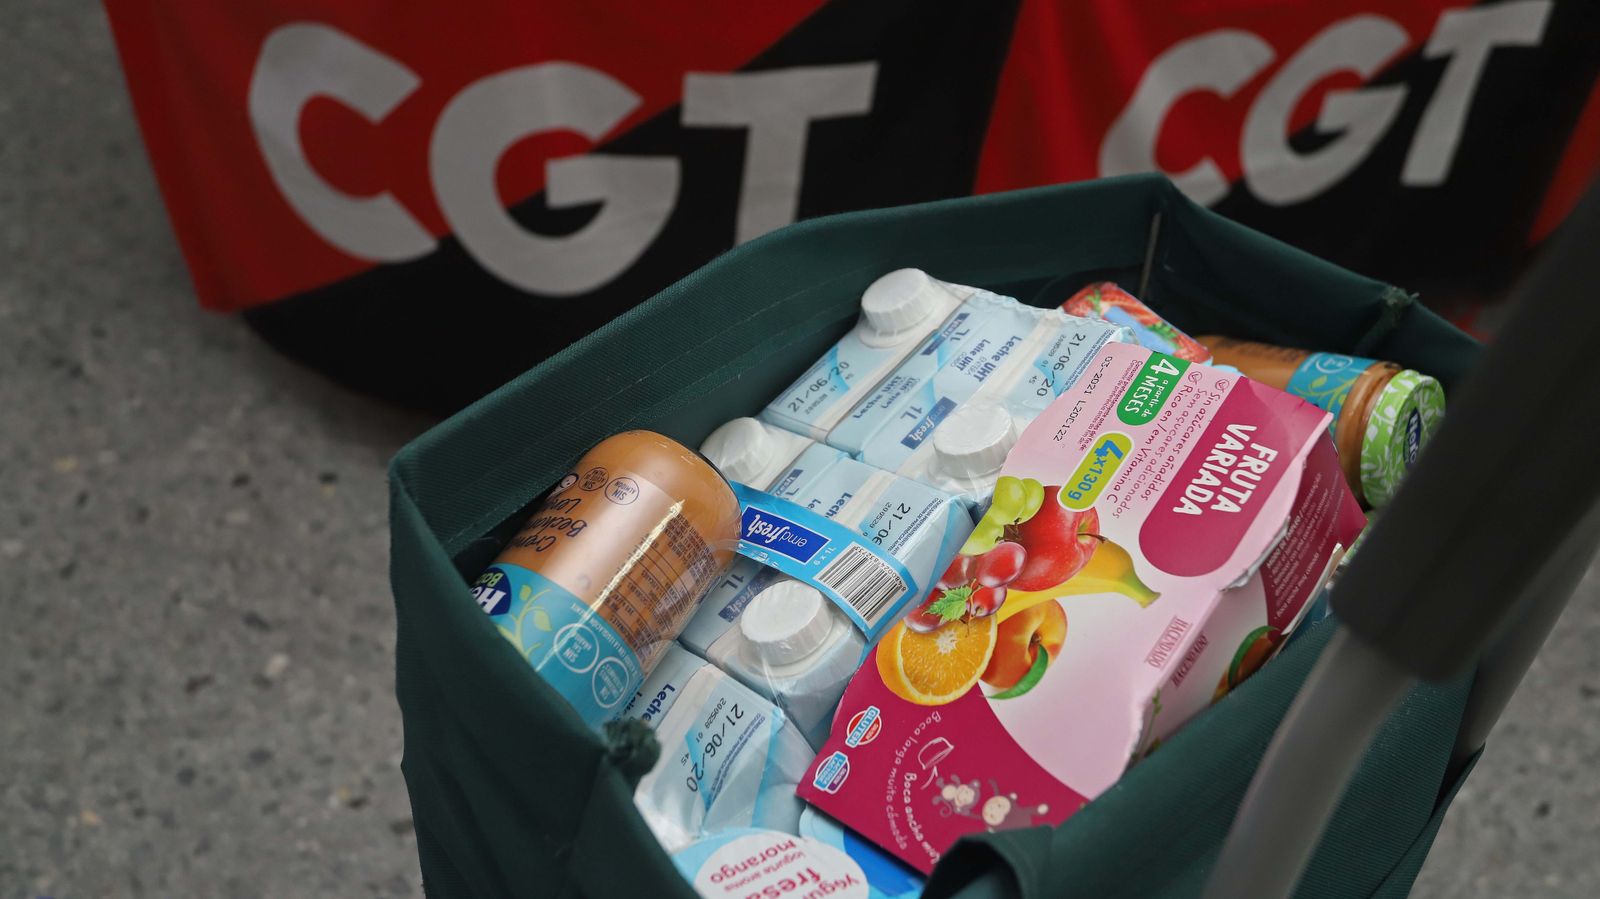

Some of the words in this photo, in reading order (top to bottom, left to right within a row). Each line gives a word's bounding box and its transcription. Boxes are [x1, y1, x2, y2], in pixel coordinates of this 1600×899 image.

[1097, 0, 1553, 207] CGT
[248, 22, 879, 297] CGT
[955, 355, 973, 371] UHT
[968, 338, 989, 357] Leite
[990, 334, 1021, 362] Leche
[972, 361, 995, 382] UHT
[1035, 332, 1085, 398] 21/06/20
[1083, 354, 1113, 395] 03-2021
[1121, 359, 1136, 379] Consumir
[1125, 360, 1142, 381] Consumir
[1150, 358, 1179, 372] 4
[787, 358, 850, 413] 21/06/20
[1124, 372, 1157, 415] MESES
[1147, 383, 1164, 408] partir
[1161, 378, 1169, 386] a
[1169, 383, 1192, 408] Rico
[899, 403, 922, 423] 1L
[1140, 408, 1151, 418] de
[1186, 387, 1207, 409] Sem
[1203, 391, 1220, 406] Sin
[1171, 407, 1206, 454] azúcares
[1112, 447, 1147, 492] Vitamina
[1139, 454, 1176, 501] añadidos
[1173, 424, 1257, 515] VARIADA
[1211, 443, 1278, 513] FRUTA
[611, 488, 626, 501] SIN
[1105, 492, 1118, 504] C
[1111, 457, 1158, 519] adicionados
[746, 514, 807, 548] emdfresh
[720, 574, 745, 589] 1L
[562, 647, 578, 663] SIN
[1147, 618, 1188, 668] HACENDADO
[646, 683, 675, 723] Leche
[703, 696, 726, 729] 200528
[694, 731, 704, 742] 01
[849, 709, 875, 744] GLUTEN
[913, 711, 943, 735] Boca
[686, 702, 742, 792] 21/06/20
[893, 737, 917, 765] larga
[884, 766, 896, 801] muito
[903, 772, 916, 803] Boca
[904, 806, 923, 841] ancha
[710, 839, 795, 883] morango
